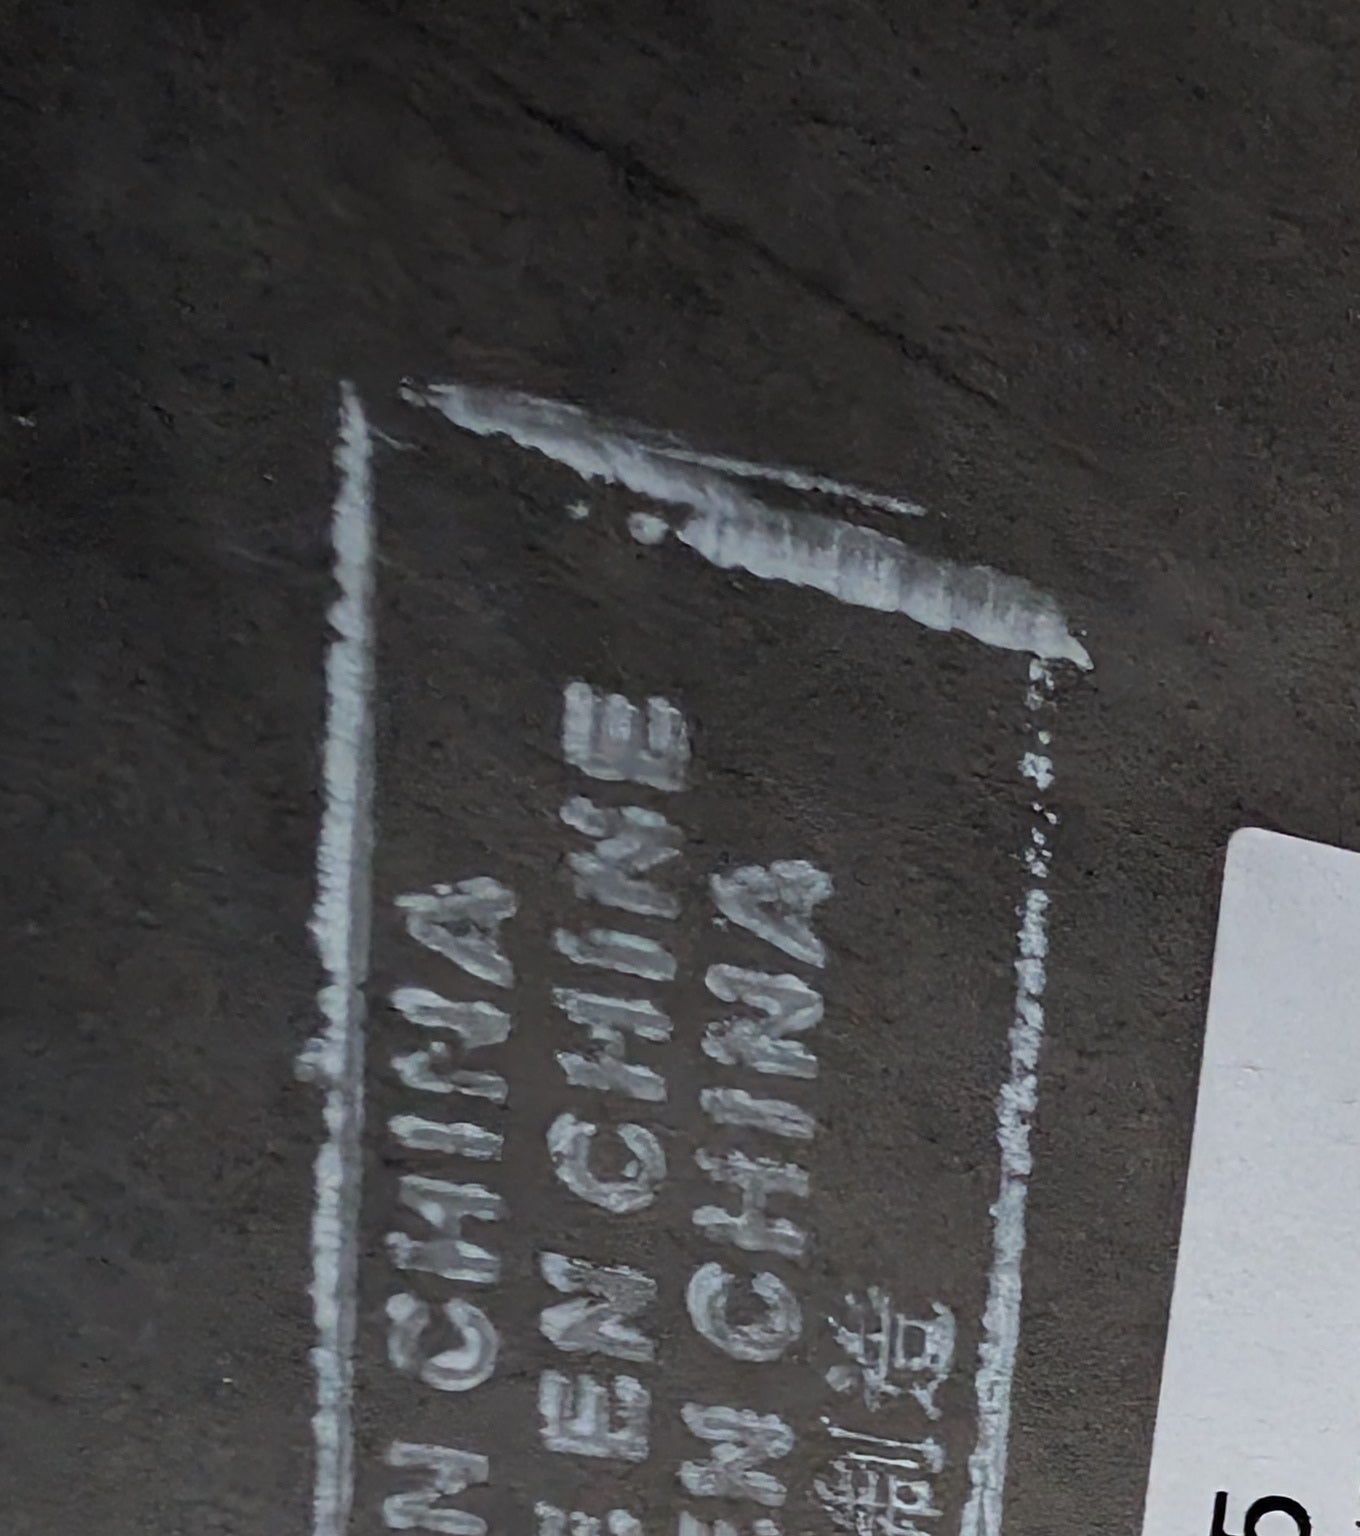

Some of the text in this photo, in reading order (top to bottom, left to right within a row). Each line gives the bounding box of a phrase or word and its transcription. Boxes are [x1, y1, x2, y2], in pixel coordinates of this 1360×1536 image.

[387, 875, 518, 1392] CHINA
[546, 680, 693, 1213] CHINE
[684, 858, 835, 1361] CHINA
[537, 1251, 658, 1461] EN
